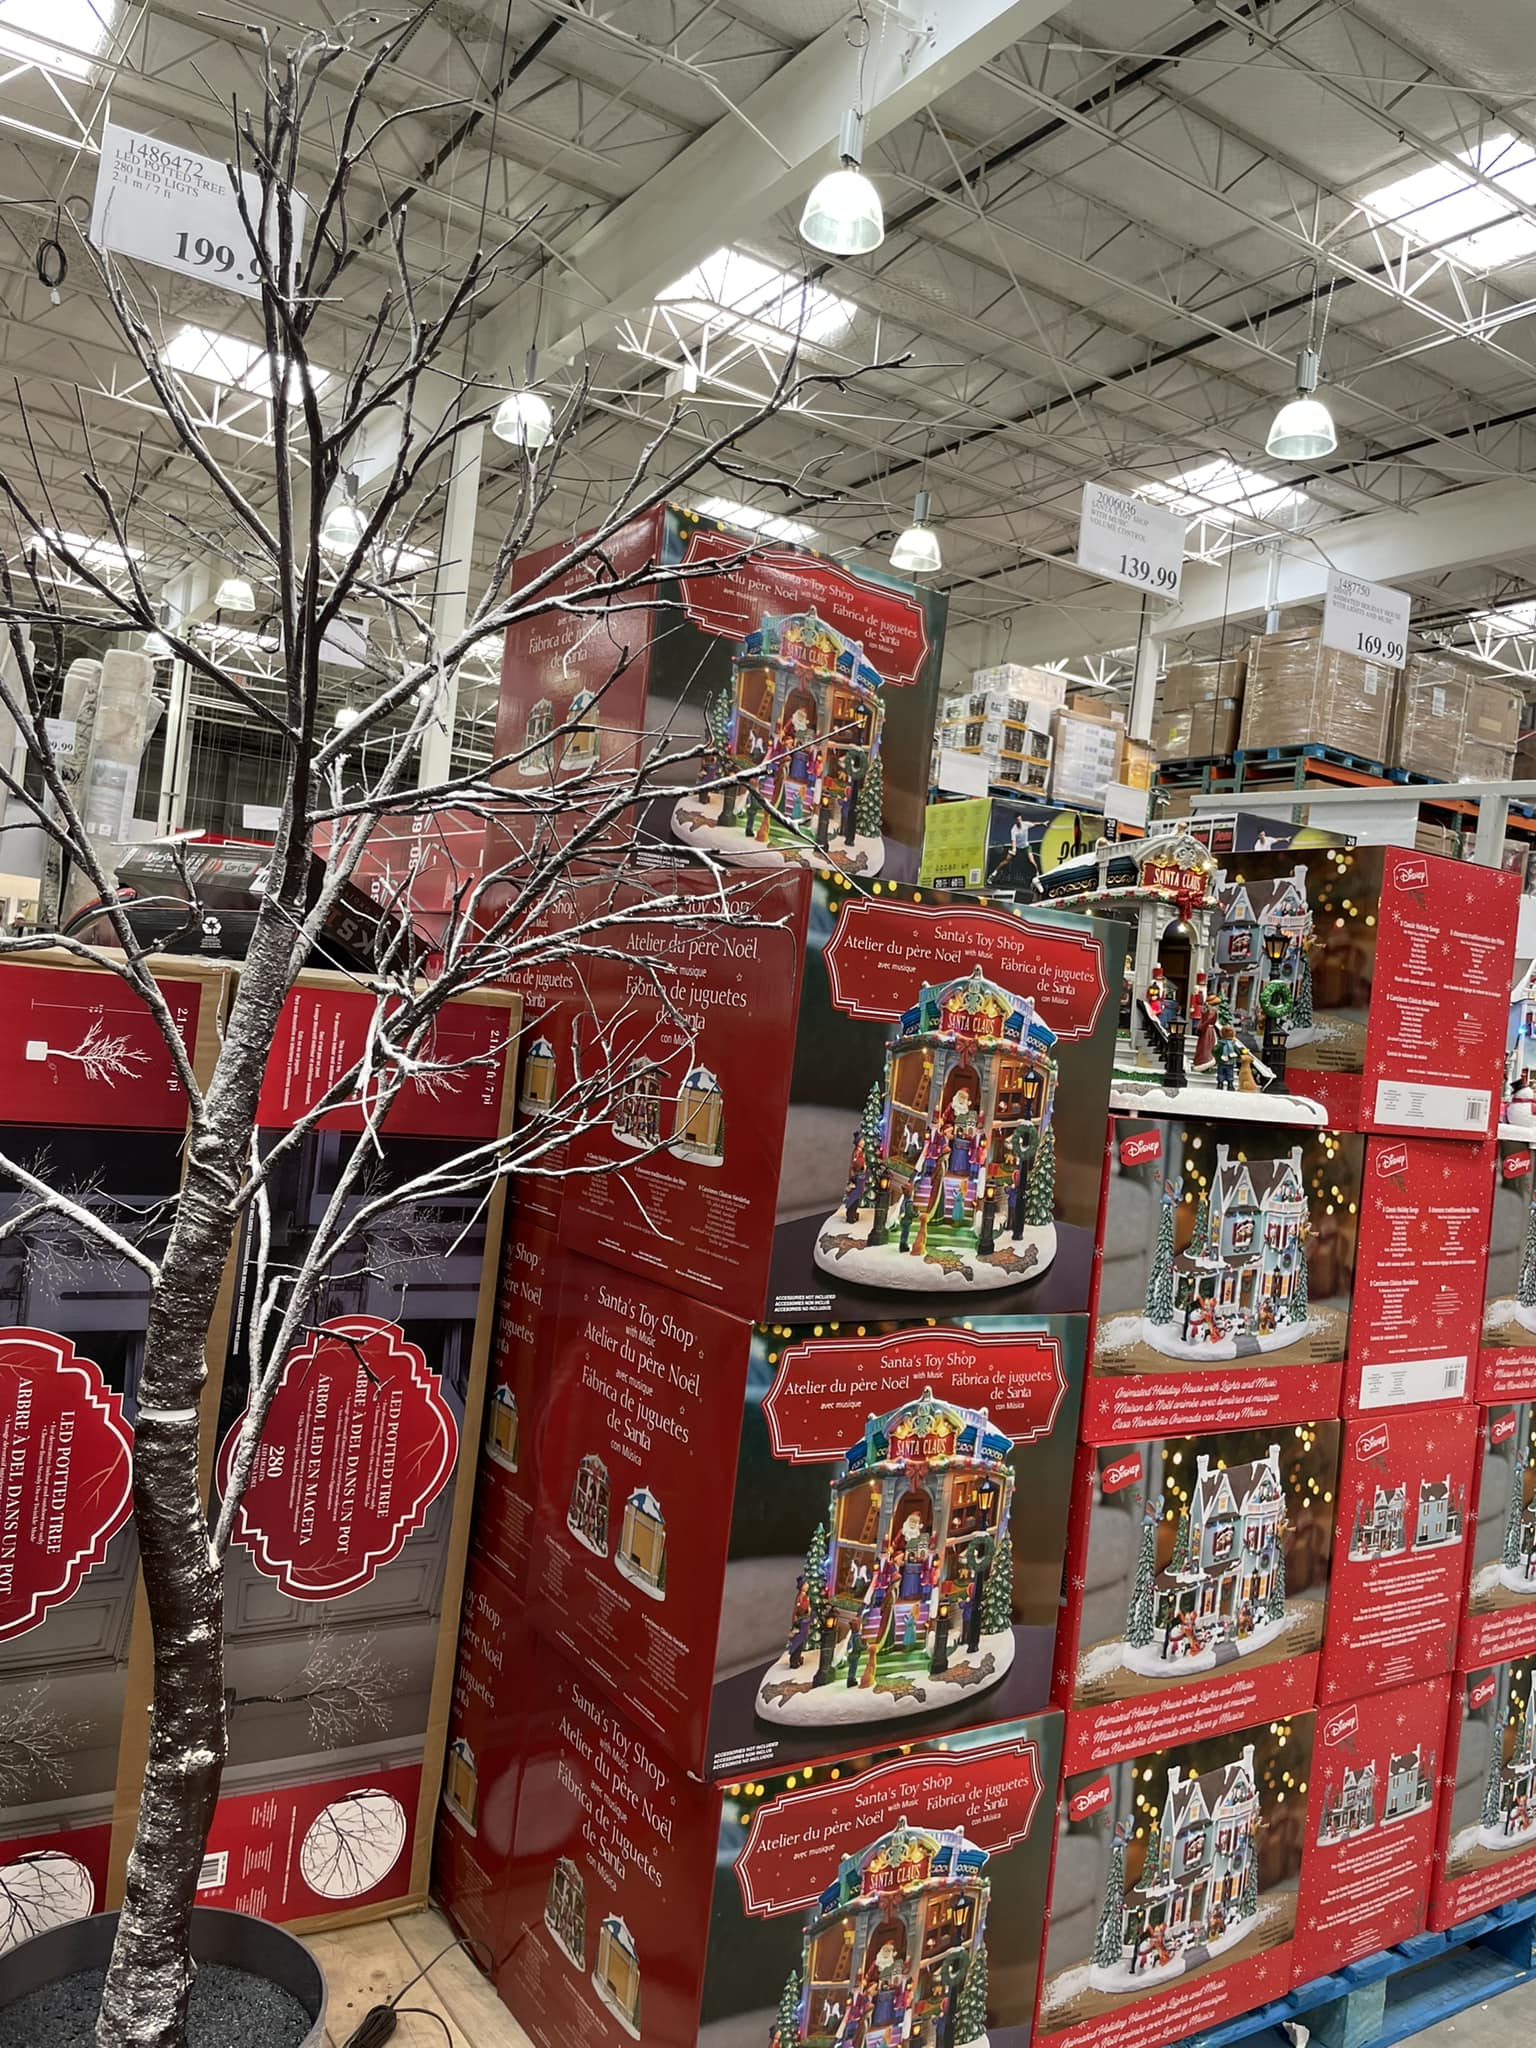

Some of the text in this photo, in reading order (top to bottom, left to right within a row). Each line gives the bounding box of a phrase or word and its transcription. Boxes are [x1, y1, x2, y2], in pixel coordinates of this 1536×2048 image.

[129, 139, 204, 178] 1486472
[113, 160, 200, 198] 280 LED LIGTS
[116, 149, 226, 196] LED POTTED TREE
[112, 171, 128, 184] 2.1
[133, 180, 143, 190] m
[154, 186, 161, 194] 7
[163, 189, 171, 199] ft
[173, 231, 288, 289] 199.9
[1096, 491, 1136, 515] 2006036
[1120, 555, 1177, 590] 139.99
[748, 578, 772, 593] père
[774, 584, 798, 602] Noël
[828, 584, 855, 602] Shop
[832, 603, 919, 641] Fábrica de juguetes
[864, 627, 901, 648] de Santa
[1357, 632, 1404, 661] 169.99
[809, 648, 829, 667] CLAUS
[1153, 867, 1201, 891] SANTA CLAUS
[1398, 866, 1426, 884] Disney
[844, 934, 961, 964] Atelier du père Noël
[934, 926, 1025, 955] Santa's Toy Shop
[877, 961, 917, 974] avec musique
[1001, 957, 1095, 983] Fábrica de juguetes
[1036, 978, 1076, 996] de Santa
[947, 1014, 995, 1034] SANTA CLAUS
[166, 1077, 181, 1092] pi
[481, 1094, 493, 1105] pi
[1124, 1138, 1160, 1158] Disney
[1380, 1153, 1406, 1171] Disney
[1507, 1155, 1532, 1172] Disney
[598, 1285, 695, 1352] Santa's Toy Shop
[625, 1324, 657, 1349] with Music
[583, 1321, 701, 1398] Atelier du père Noël
[880, 1350, 976, 1370] Santa's Toy Shop
[615, 1367, 655, 1398] avec musique
[784, 1375, 910, 1397] Atelier du père Noël
[951, 1371, 1052, 1388] Fábrica de juguetes
[1151, 1385, 1181, 1398] Holiday
[1181, 1383, 1203, 1394] House
[1220, 1379, 1241, 1392] Lights
[1255, 1377, 1277, 1388] Music
[990, 1386, 1032, 1401] de Santa
[352, 1410, 367, 1421] À
[348, 1423, 363, 1449] DEL
[1494, 1420, 1516, 1438] Disney
[376, 1390, 403, 1519] LED POTTED TREE
[896, 1438, 946, 1456] SANTA CLAUS
[1362, 1434, 1387, 1453] Disney
[267, 1446, 286, 1478] 280
[299, 1373, 333, 1546] ÁRBOL LED EN MACETA
[46, 1410, 76, 1555] LED POTTED TREE
[343, 1455, 360, 1497] DANS
[1109, 1463, 1140, 1485] Disney
[340, 1499, 353, 1522] UN
[336, 1525, 351, 1555] POT
[1472, 1682, 1496, 1702] Disney
[1330, 1716, 1356, 1738] Disney
[855, 1775, 953, 1809] Santa's Toy Shop
[1074, 1787, 1110, 1812] Disney
[756, 1809, 885, 1855] Atelier du père Noël
[869, 1862, 921, 1889] SANTA CLAUS
